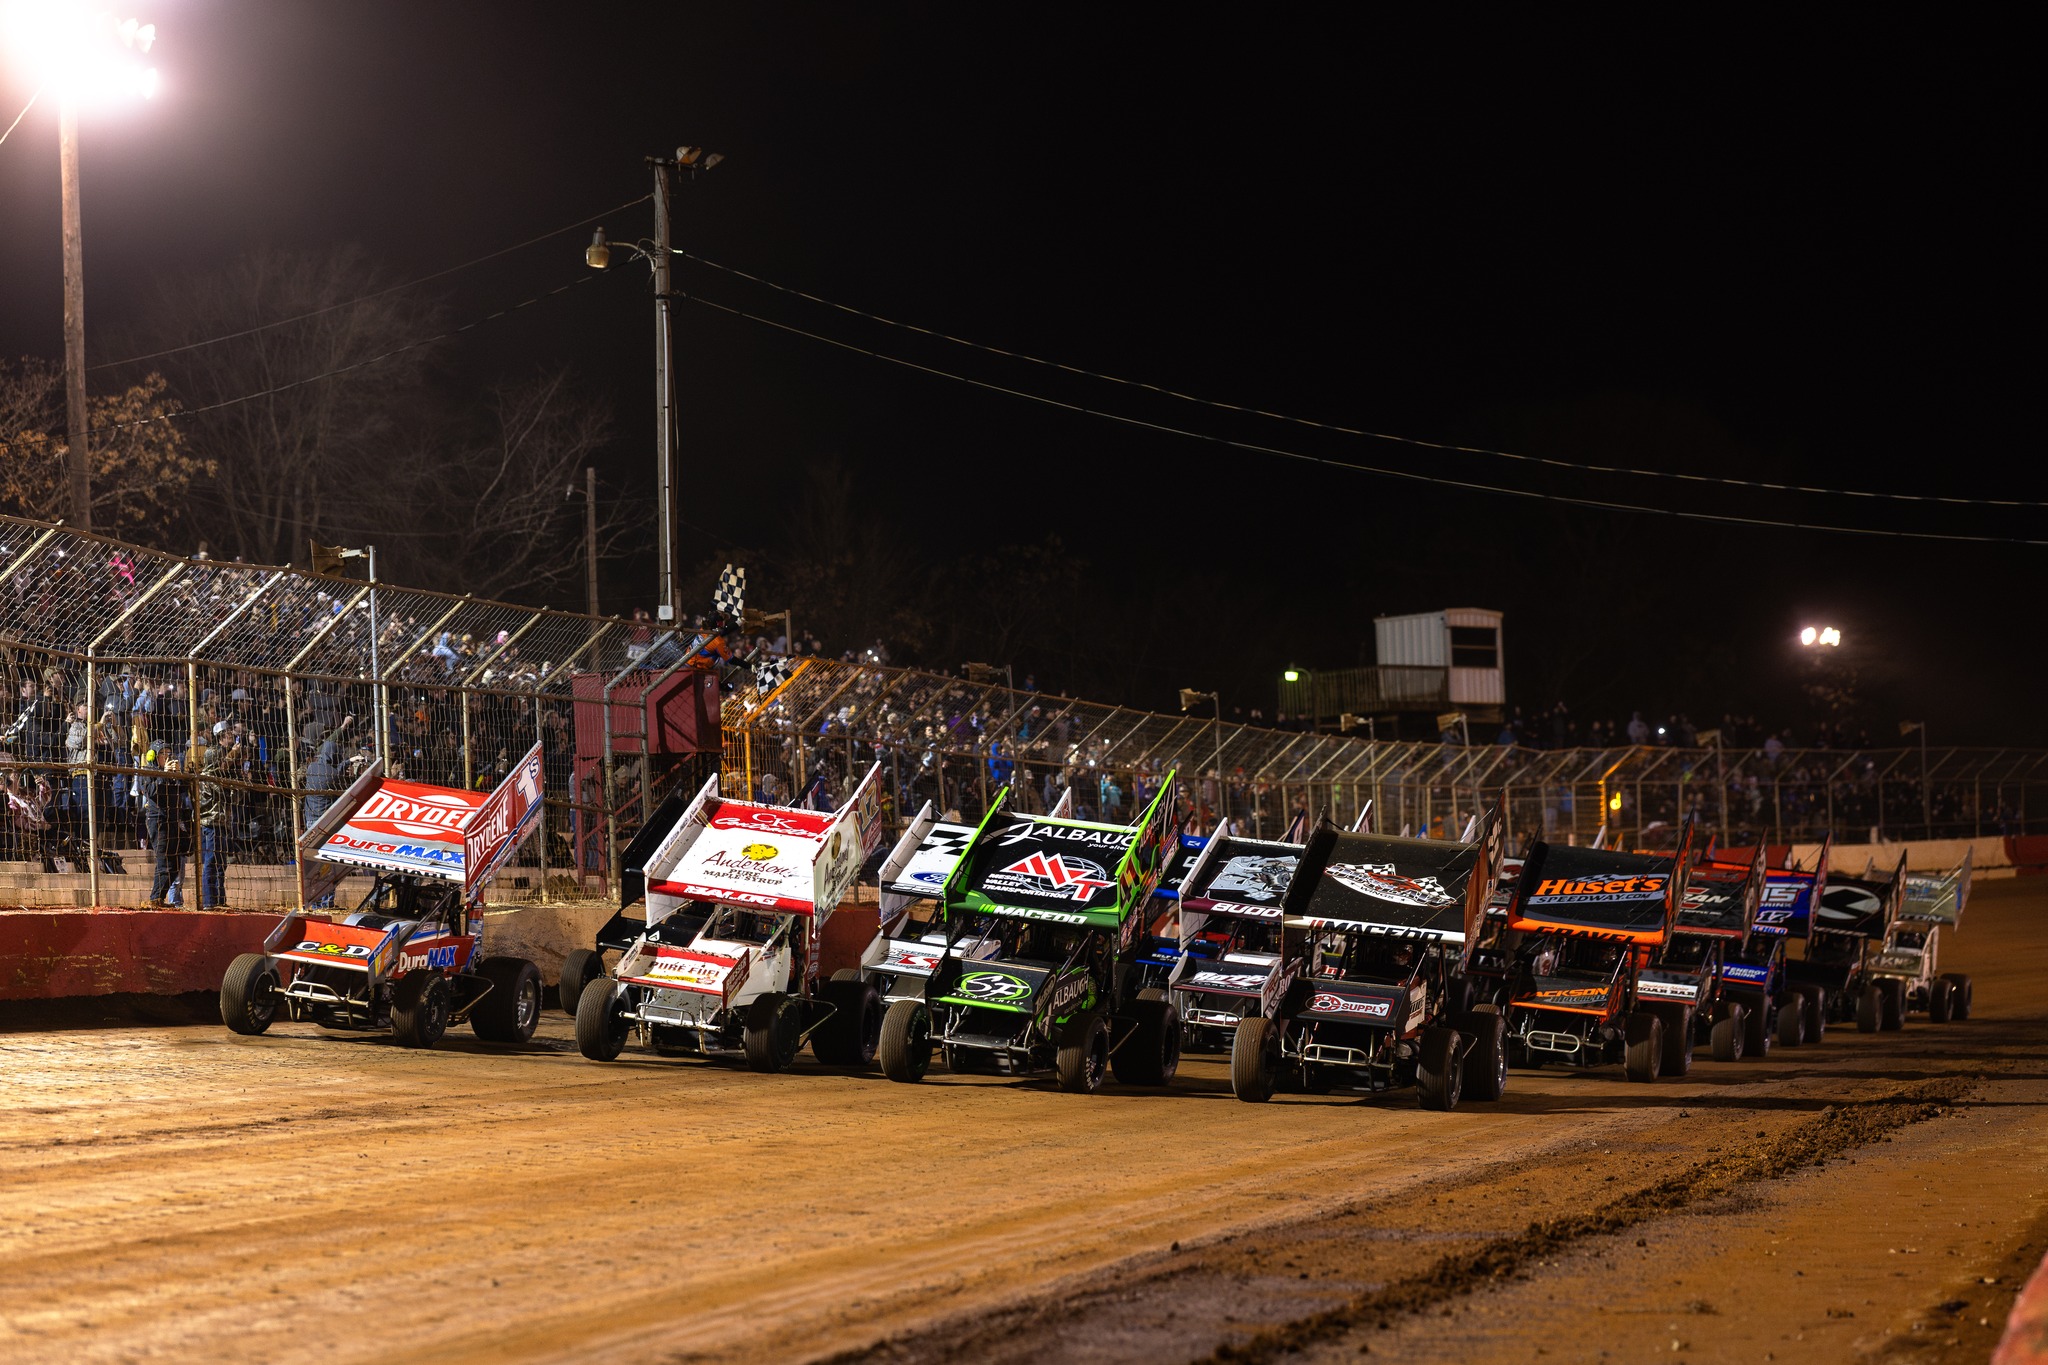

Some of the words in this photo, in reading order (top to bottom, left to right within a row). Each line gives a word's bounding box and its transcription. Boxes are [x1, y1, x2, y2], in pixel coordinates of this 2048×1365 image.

[752, 813, 798, 829] CK
[467, 796, 509, 875] DRYDENE
[327, 833, 466, 866] DuraMAX
[702, 850, 799, 878] Anderson's
[703, 869, 741, 880] MAPLE
[744, 875, 783, 886] SYRUP
[729, 868, 761, 878] PURE
[988, 873, 1032, 883] MESILLA
[982, 884, 1069, 899] TRANSPORTATION
[985, 879, 1022, 887] VALLEY
[1533, 876, 1663, 896] Huset's
[683, 884, 779, 906] BALOG
[1536, 893, 1652, 904] SPEEDWAY.COM
[992, 905, 1089, 925] MACEDO
[1211, 902, 1282, 918] BUDD
[1322, 920, 1445, 943] MACEDO
[1534, 926, 1636, 943] GRAVEL
[398, 947, 458, 973] DuraMAX
[648, 961, 686, 973] PURE
[1053, 973, 1090, 1010] ALBAUGH
[1341, 1002, 1387, 1014] SUPPLY
